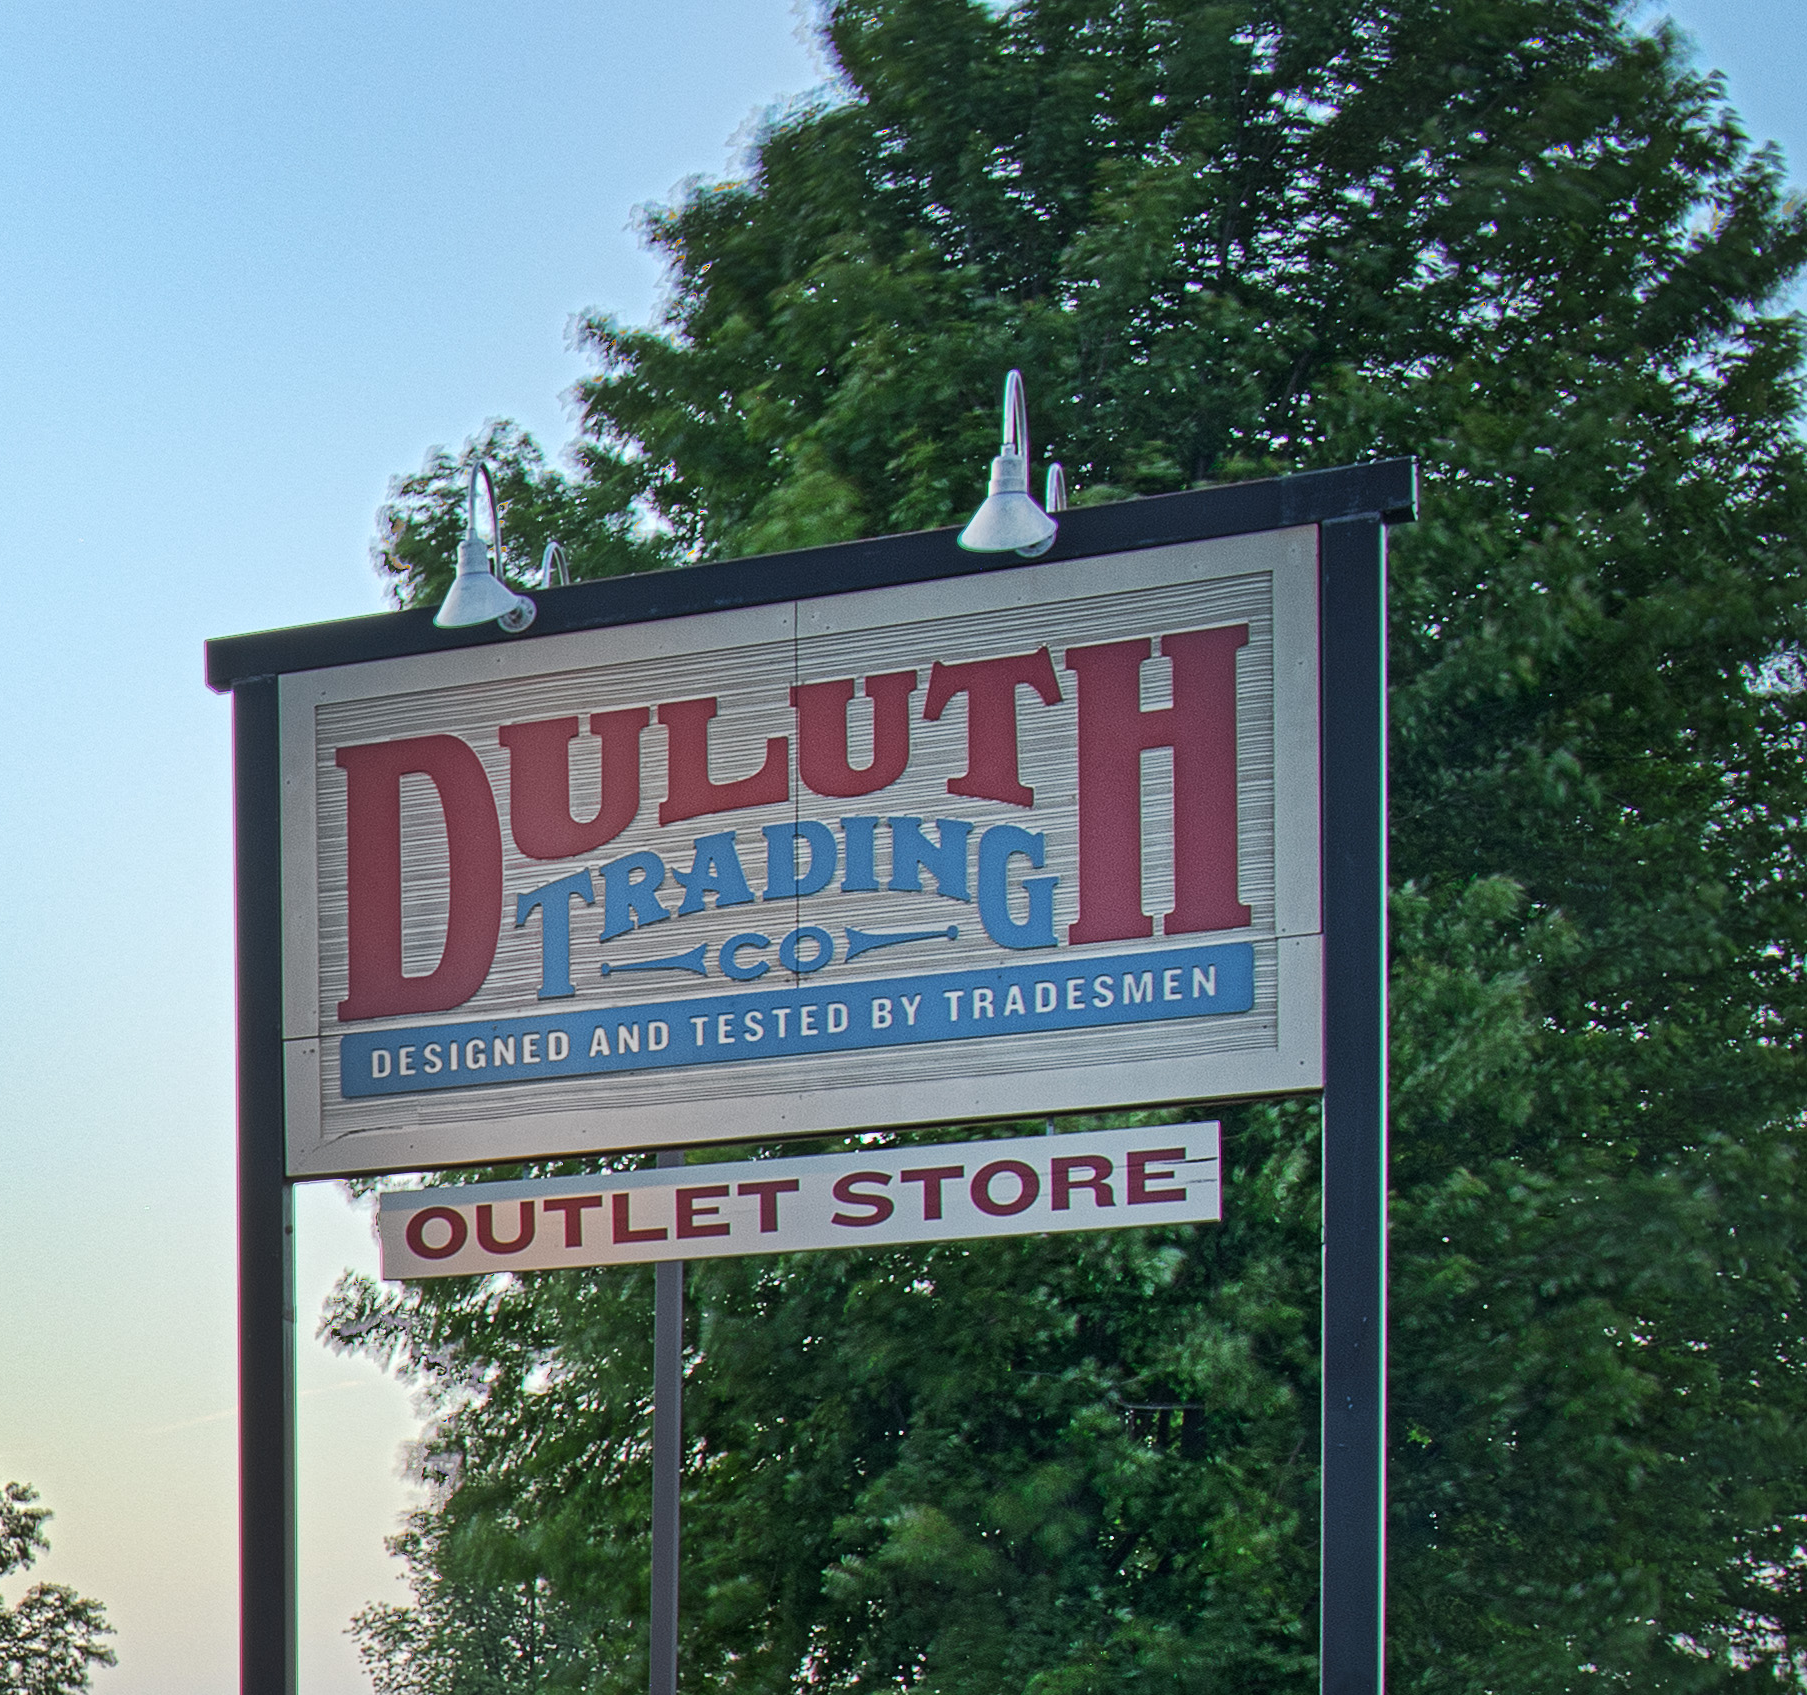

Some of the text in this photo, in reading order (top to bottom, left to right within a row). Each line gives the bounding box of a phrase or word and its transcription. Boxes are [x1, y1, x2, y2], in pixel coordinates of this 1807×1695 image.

[335, 623, 1252, 1021] DULUTH
[517, 815, 1059, 999] TRADING
[718, 924, 836, 980] CO
[371, 966, 1217, 1079] DESIGNED AND TESTED BY TRADESMEN
[405, 1149, 1188, 1260] OUTLET STORE
